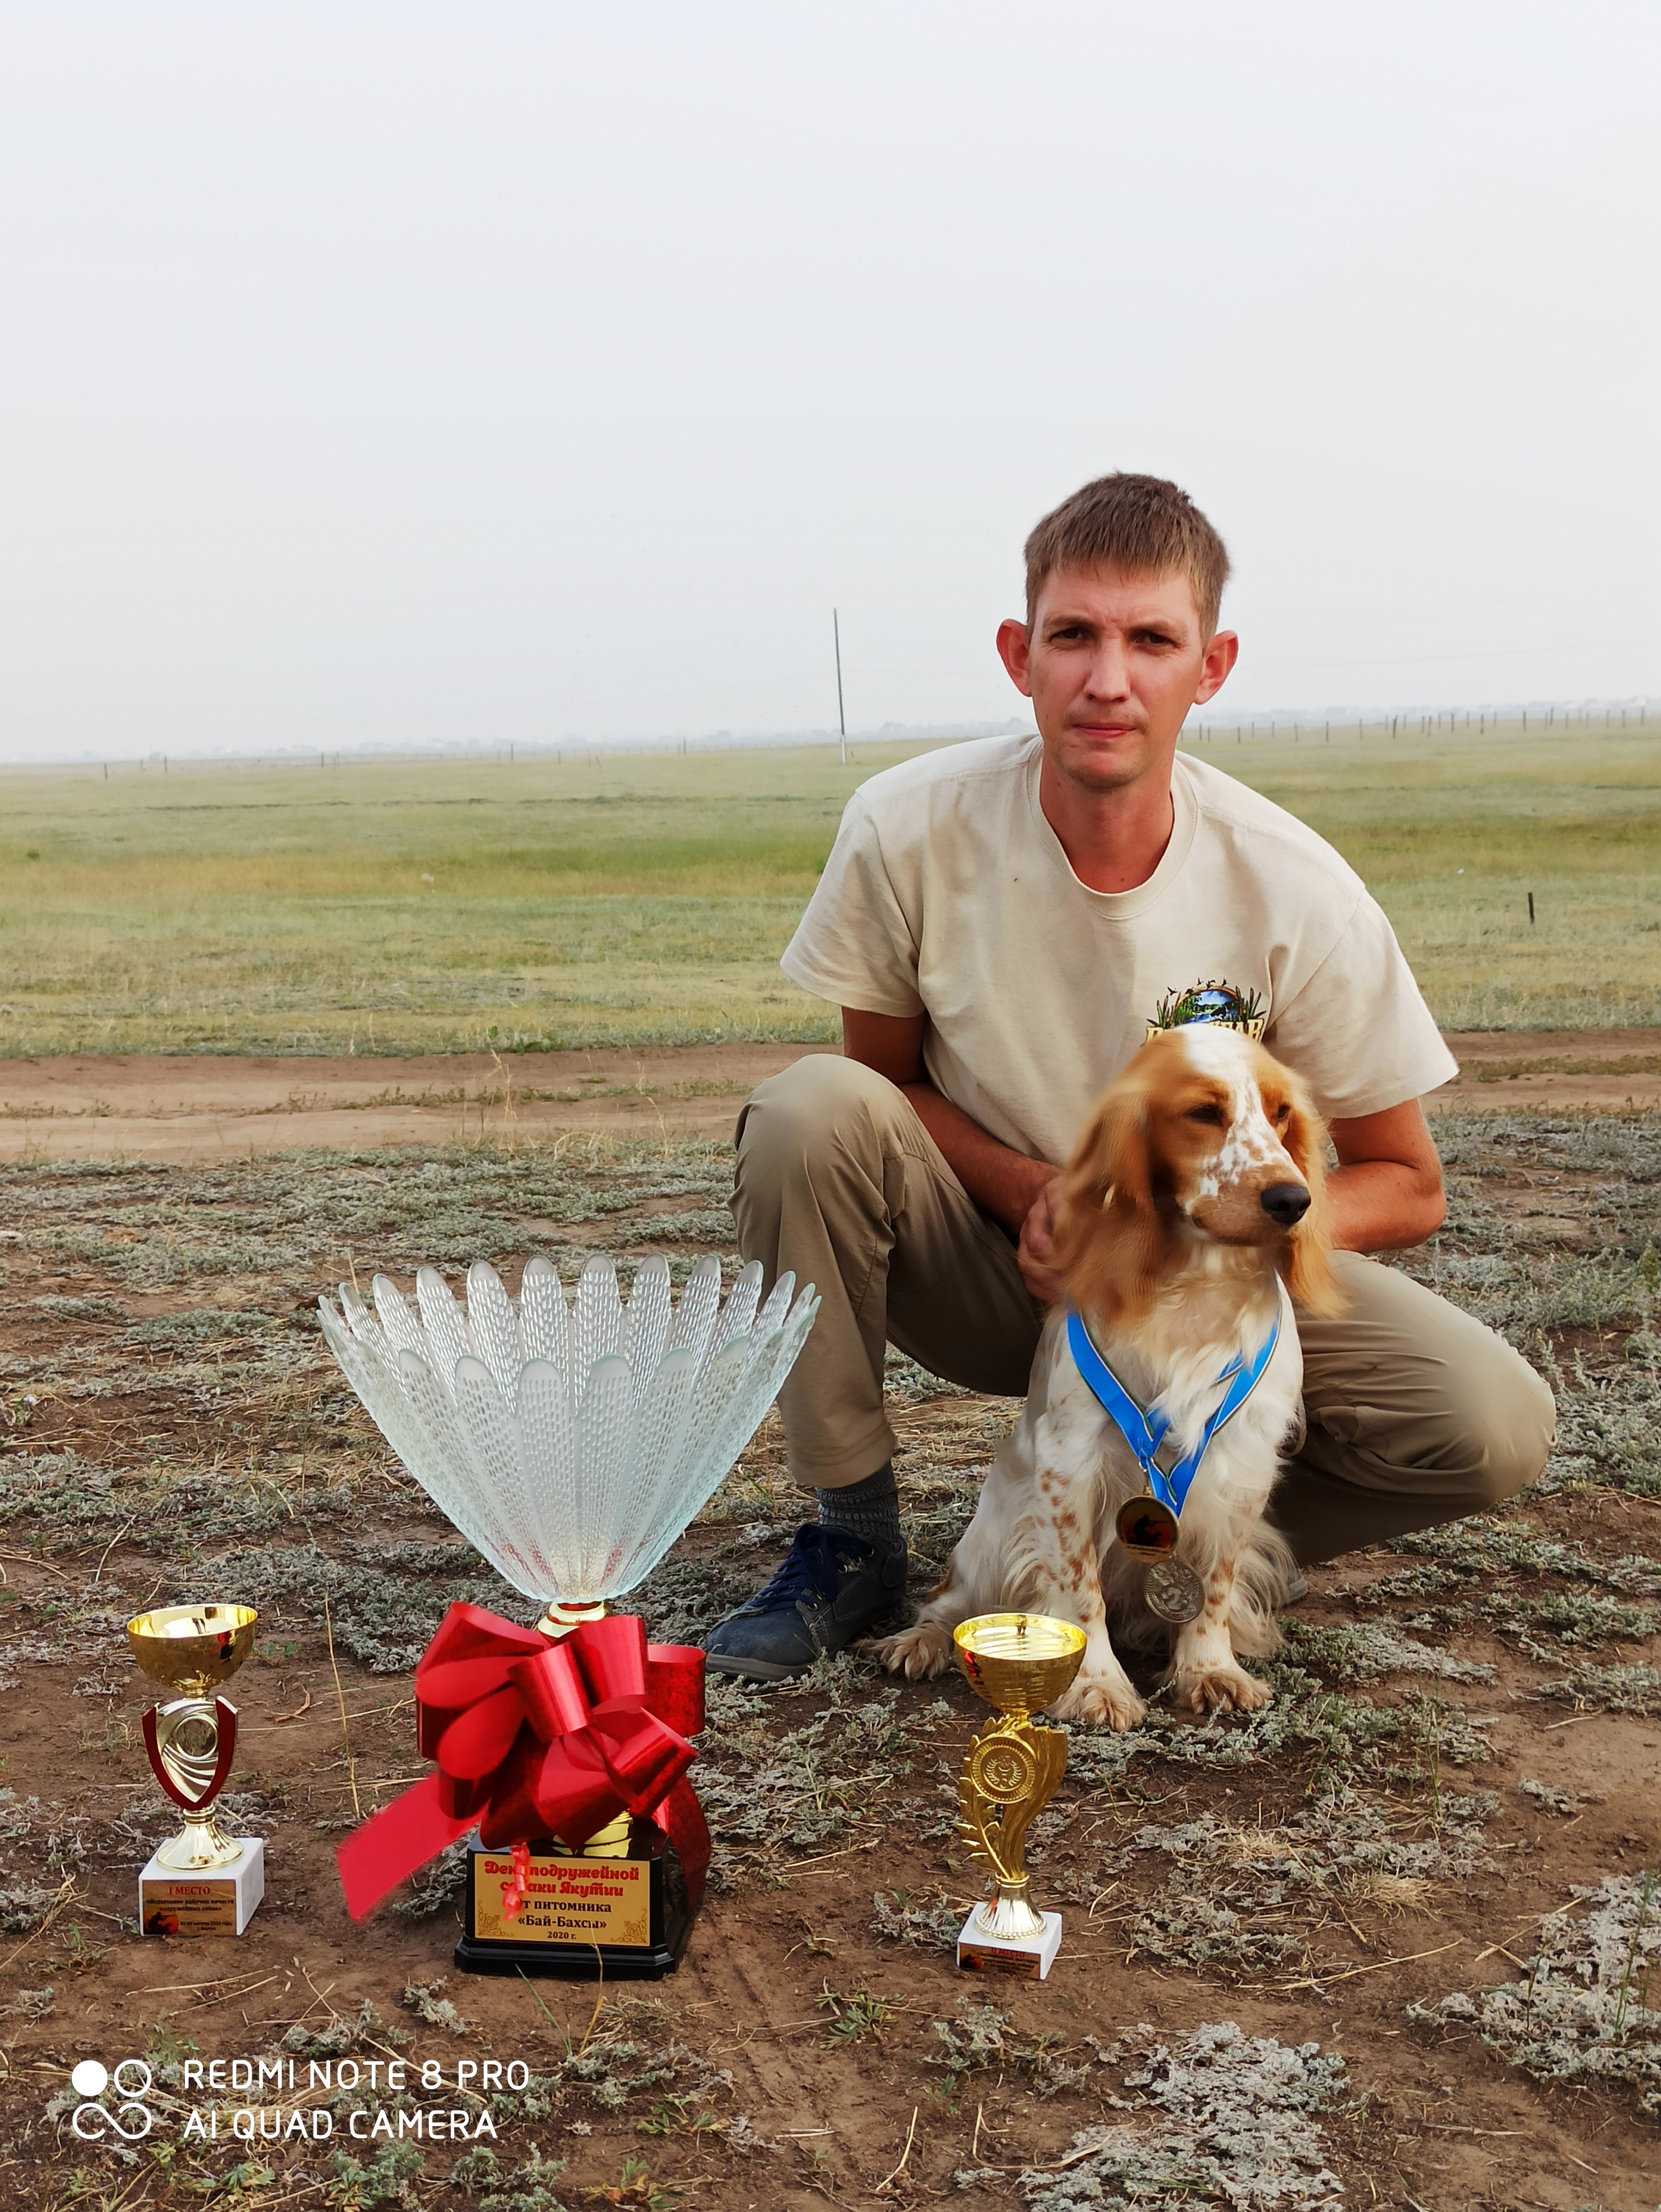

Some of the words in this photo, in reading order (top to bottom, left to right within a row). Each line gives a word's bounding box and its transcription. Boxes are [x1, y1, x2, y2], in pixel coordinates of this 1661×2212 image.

[484, 1860, 515, 1875] Ден
[529, 1863, 640, 1880] подружейной
[175, 1886, 210, 1895] МЕСТО
[500, 1881, 556, 1893] саки
[559, 1881, 624, 1898] Якутии
[534, 1900, 612, 1913] питомника
[518, 1915, 607, 1929] «Бай-Бахсы»
[547, 1931, 569, 1939] 2020
